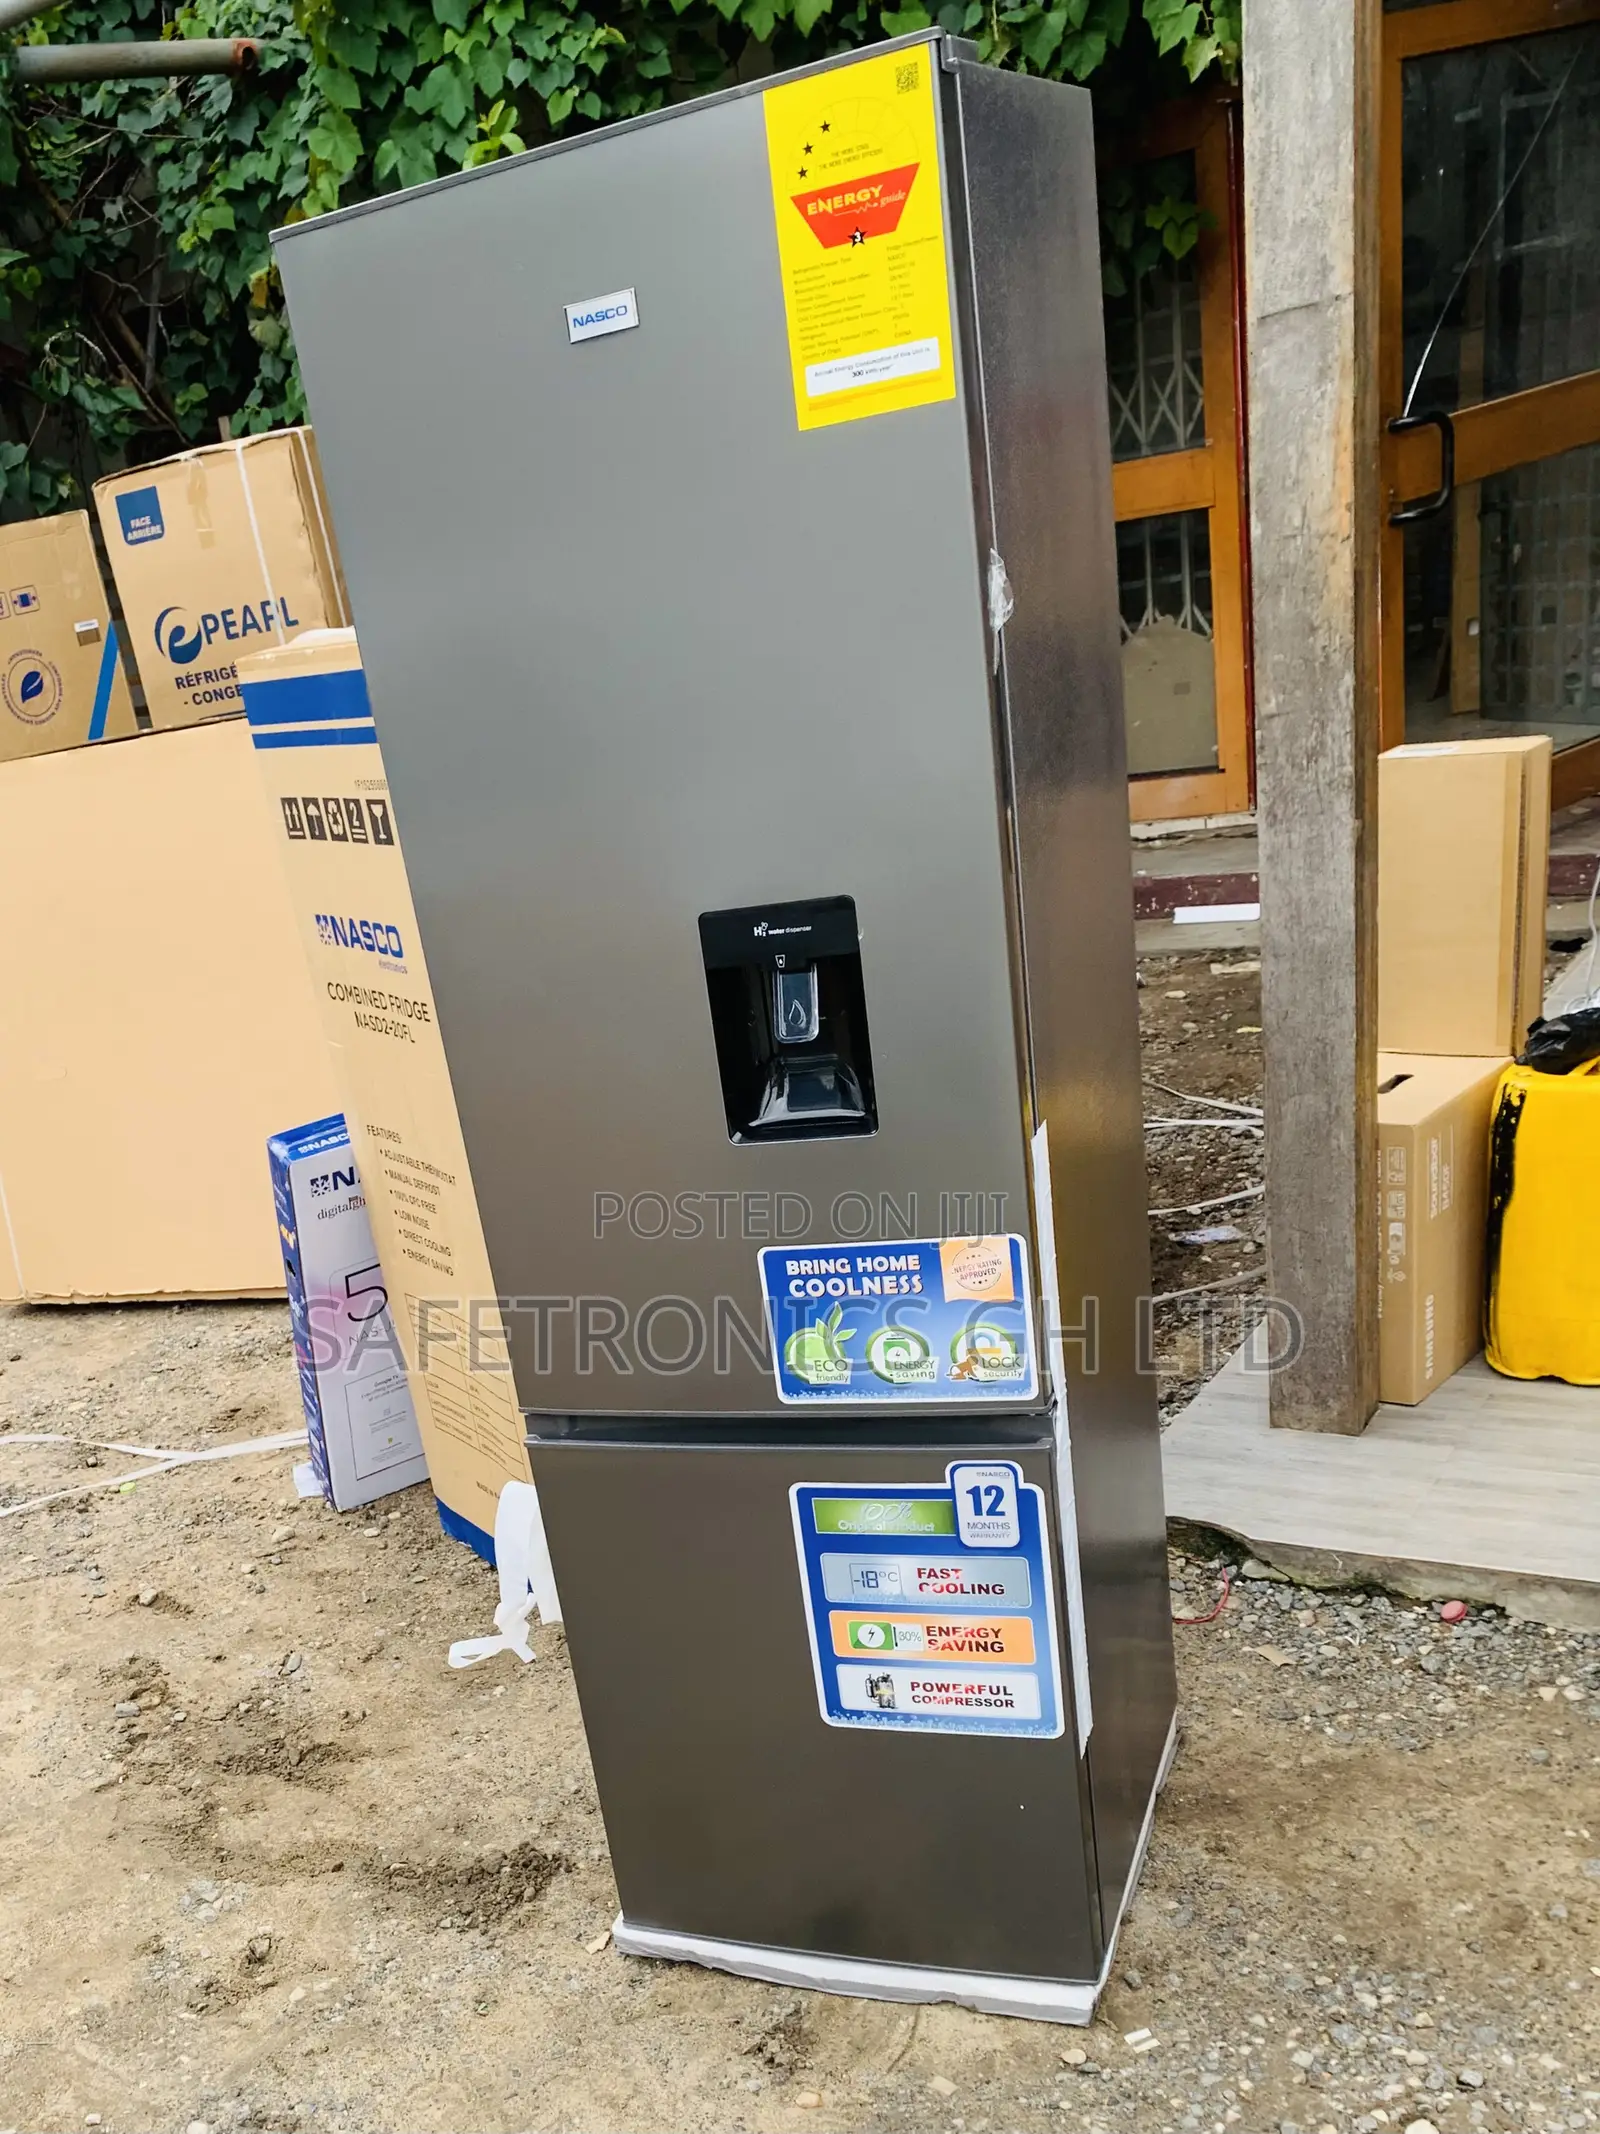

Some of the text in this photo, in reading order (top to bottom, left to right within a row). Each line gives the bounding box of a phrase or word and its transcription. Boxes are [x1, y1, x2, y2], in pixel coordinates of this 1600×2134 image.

[807, 184, 883, 216] ENERGY
[854, 231, 862, 242] 3
[572, 304, 628, 328] NASCO
[130, 515, 151, 529] FACE
[329, 914, 404, 959] NASCO
[327, 982, 431, 1022] COMBINED FRIDGE
[785, 1254, 921, 1276] BRING HOME
[960, 1267, 997, 1281] APPROVED
[788, 1273, 924, 1298] COOLNESS
[1424, 1293, 1434, 1380] SAMSUNG
[814, 1359, 848, 1372] ECO
[894, 1360, 935, 1370] ENERGY
[982, 1357, 1022, 1368] LOCK
[816, 1373, 849, 1383] friendly
[895, 1370, 936, 1380] saving
[984, 1370, 1023, 1378] security
[966, 1485, 1006, 1516] 12
[967, 1522, 1011, 1530] MONTHS
[916, 1567, 962, 1581] FAST
[918, 1582, 1005, 1595] COOLING
[926, 1625, 1002, 1639] ENERGY
[927, 1639, 1004, 1653] SAVING
[910, 1681, 1013, 1696] POWERFUL
[912, 1695, 1015, 1708] COMPRESSOR
